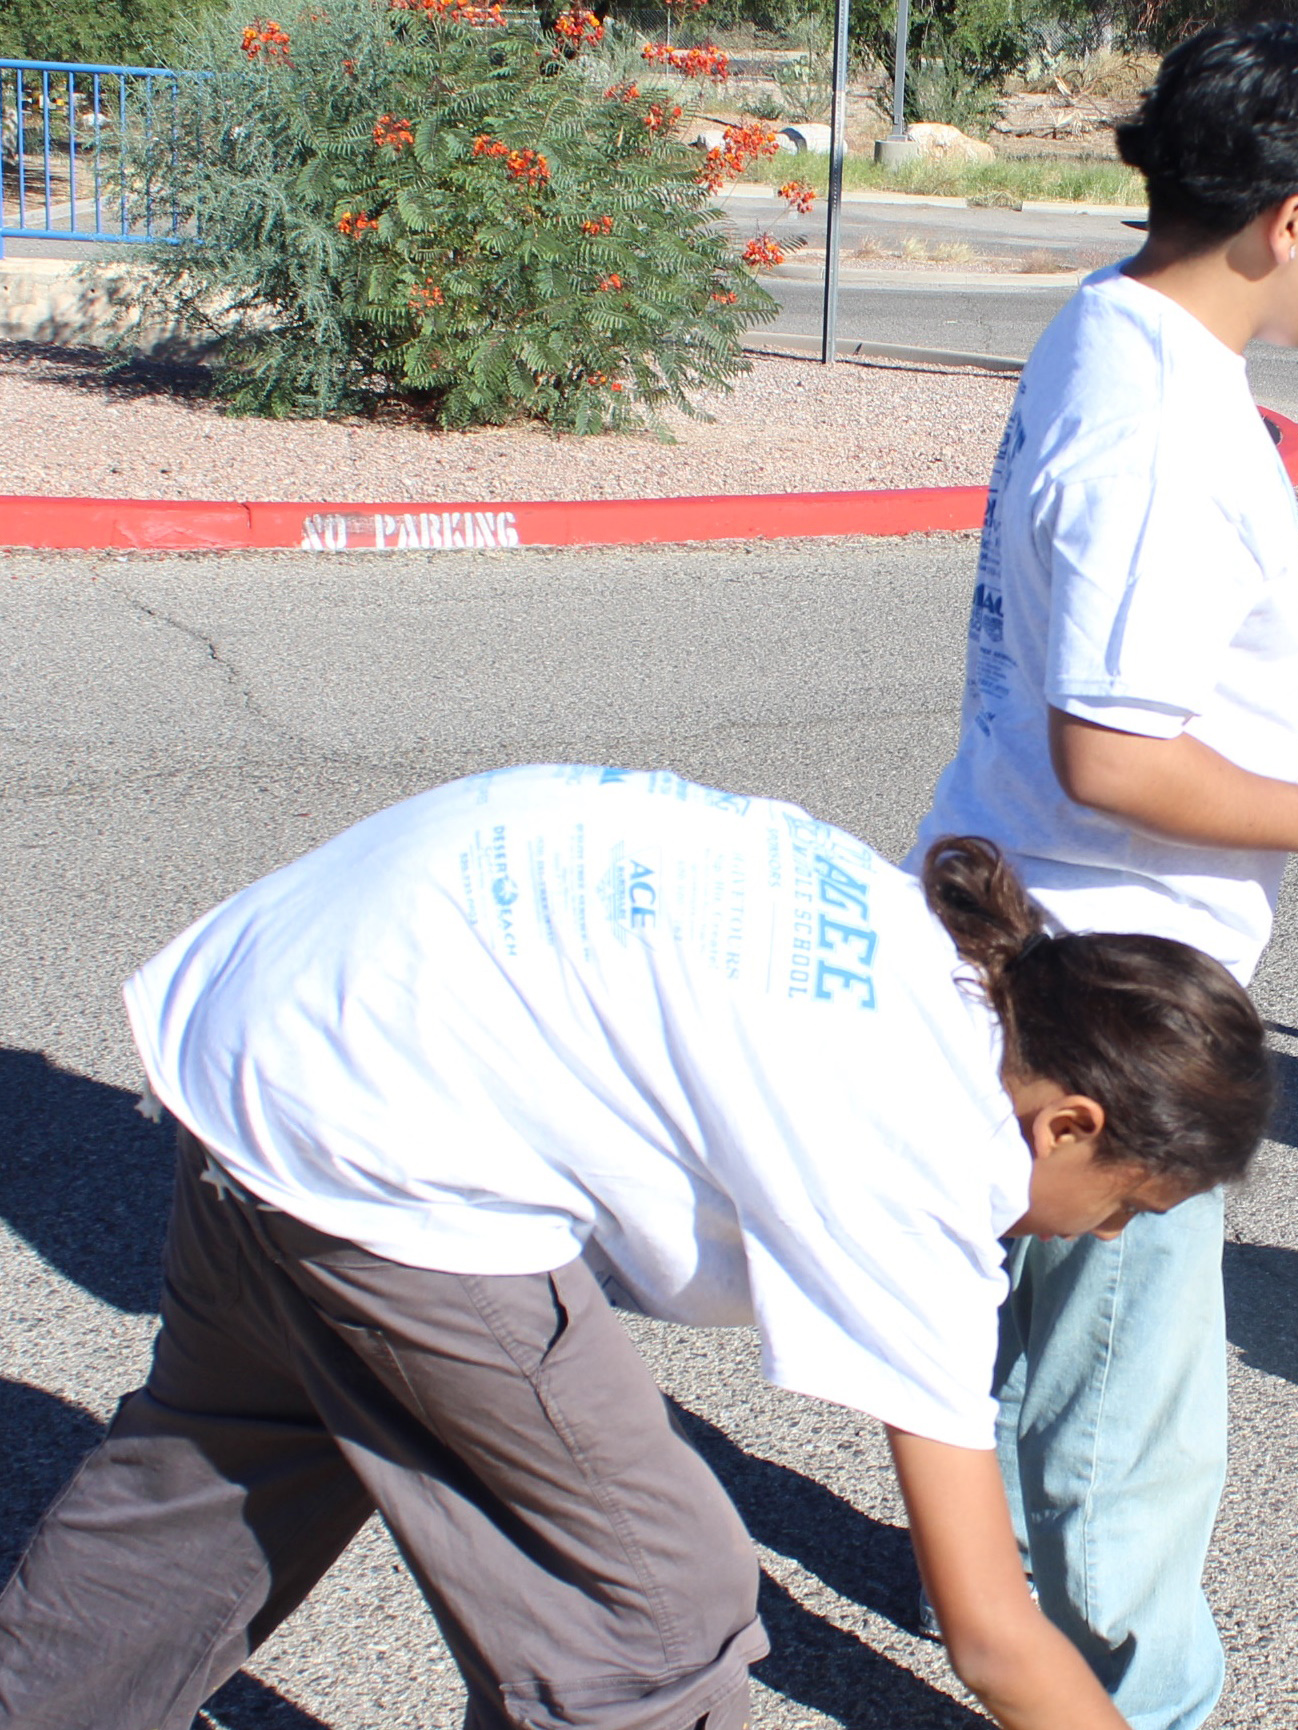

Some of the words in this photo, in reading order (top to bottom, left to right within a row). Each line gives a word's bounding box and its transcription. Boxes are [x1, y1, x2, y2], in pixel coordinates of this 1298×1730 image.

[300, 513, 347, 550] NO
[374, 512, 519, 550] PARKING
[630, 859, 657, 930] ACE
[788, 907, 813, 999] SCHOOL
